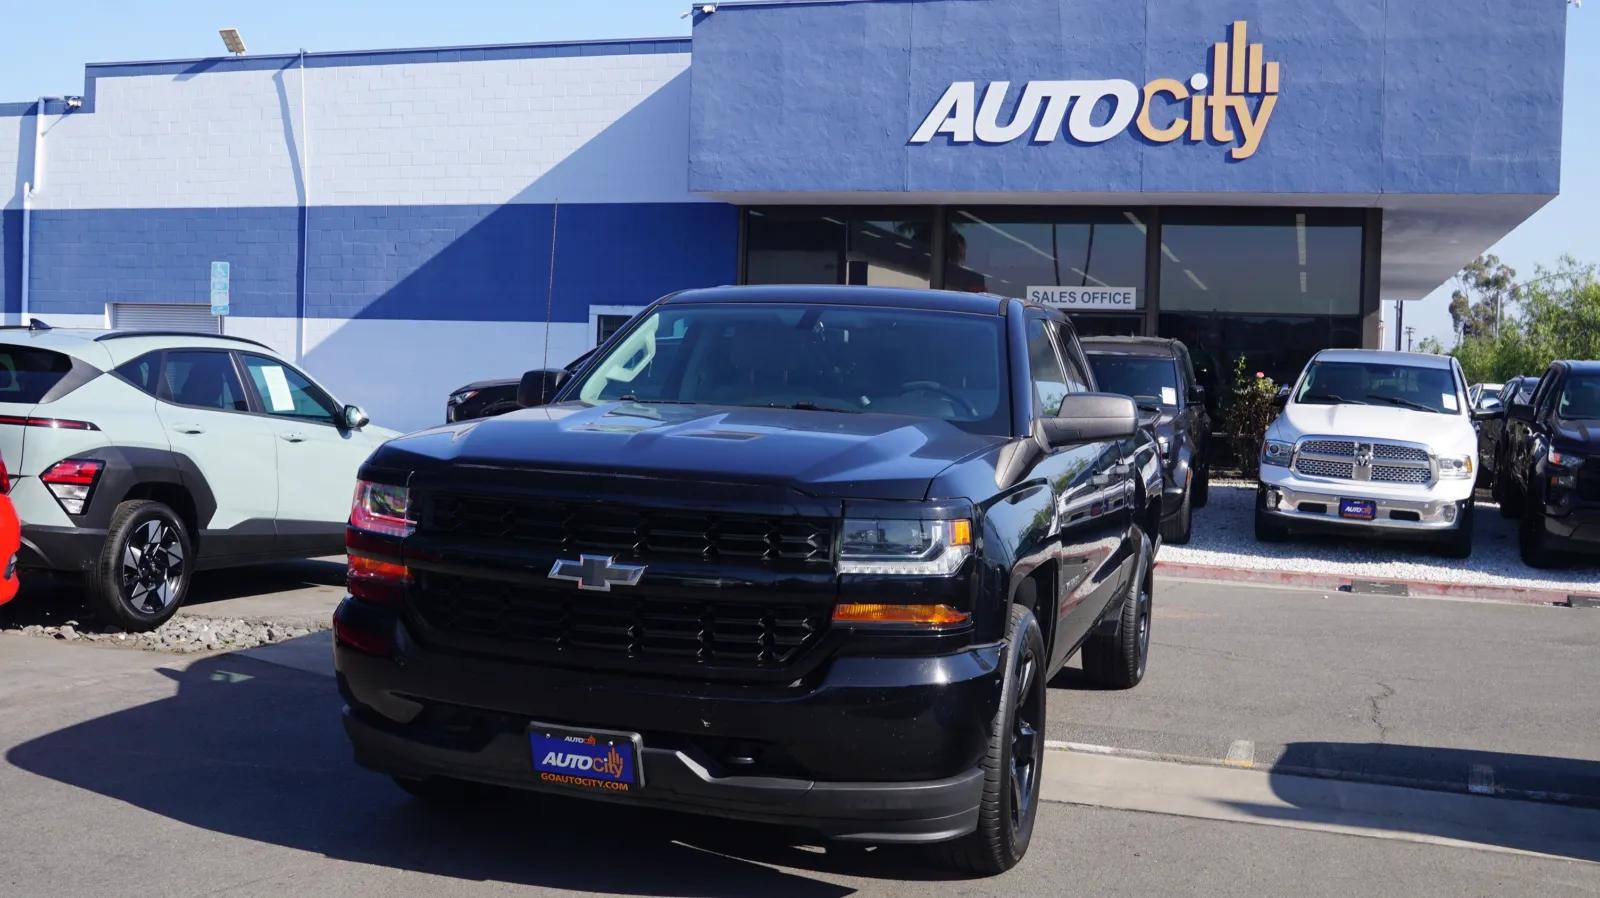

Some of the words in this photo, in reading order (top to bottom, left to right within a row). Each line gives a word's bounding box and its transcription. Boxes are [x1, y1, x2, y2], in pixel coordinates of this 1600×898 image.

[1032, 291, 1077, 304] SALES
[1081, 292, 1131, 304] OFFICE
[541, 773, 628, 791] GOAUTOCITY.COM
